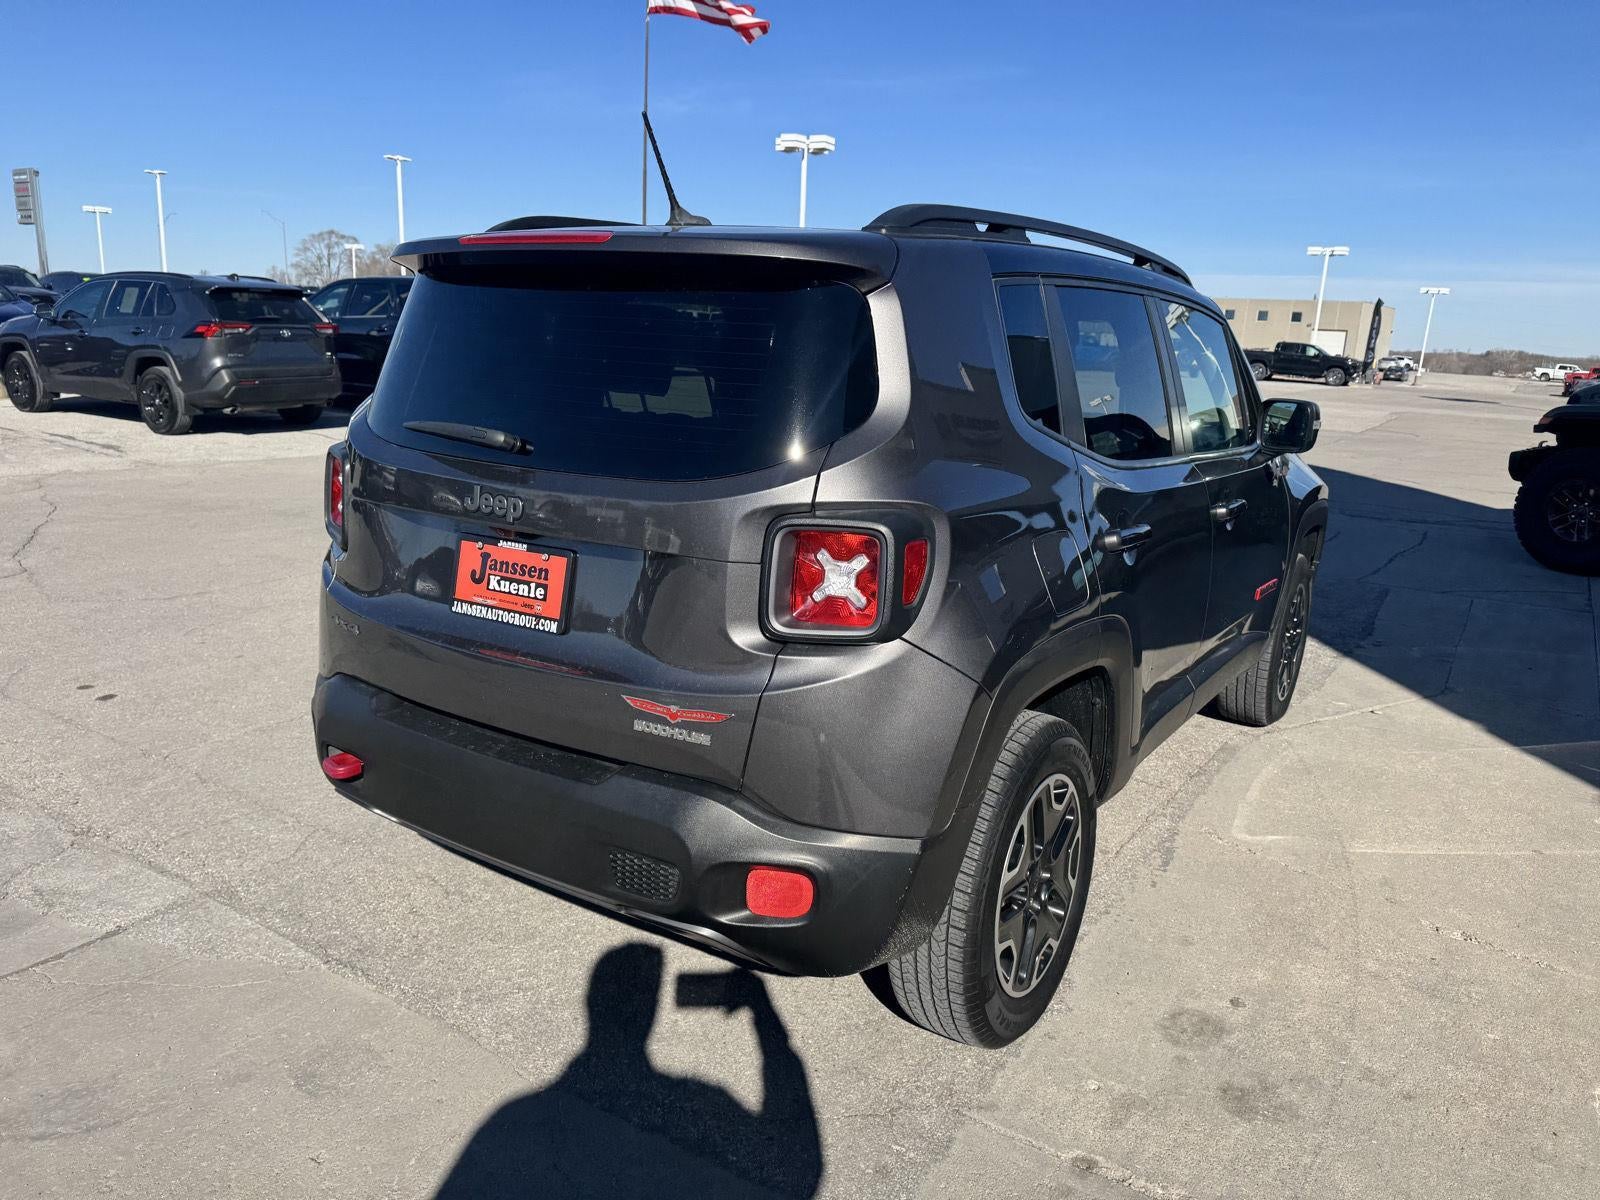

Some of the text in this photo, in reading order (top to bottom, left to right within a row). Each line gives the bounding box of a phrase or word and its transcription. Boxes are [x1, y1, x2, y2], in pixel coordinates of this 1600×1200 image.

[463, 485, 523, 523] Jeep
[497, 540, 528, 552] JANSSEN
[470, 552, 550, 584] Janssen
[488, 575, 545, 599] Kuenle
[451, 600, 558, 634] JANSSENAUTOGROUP.COM
